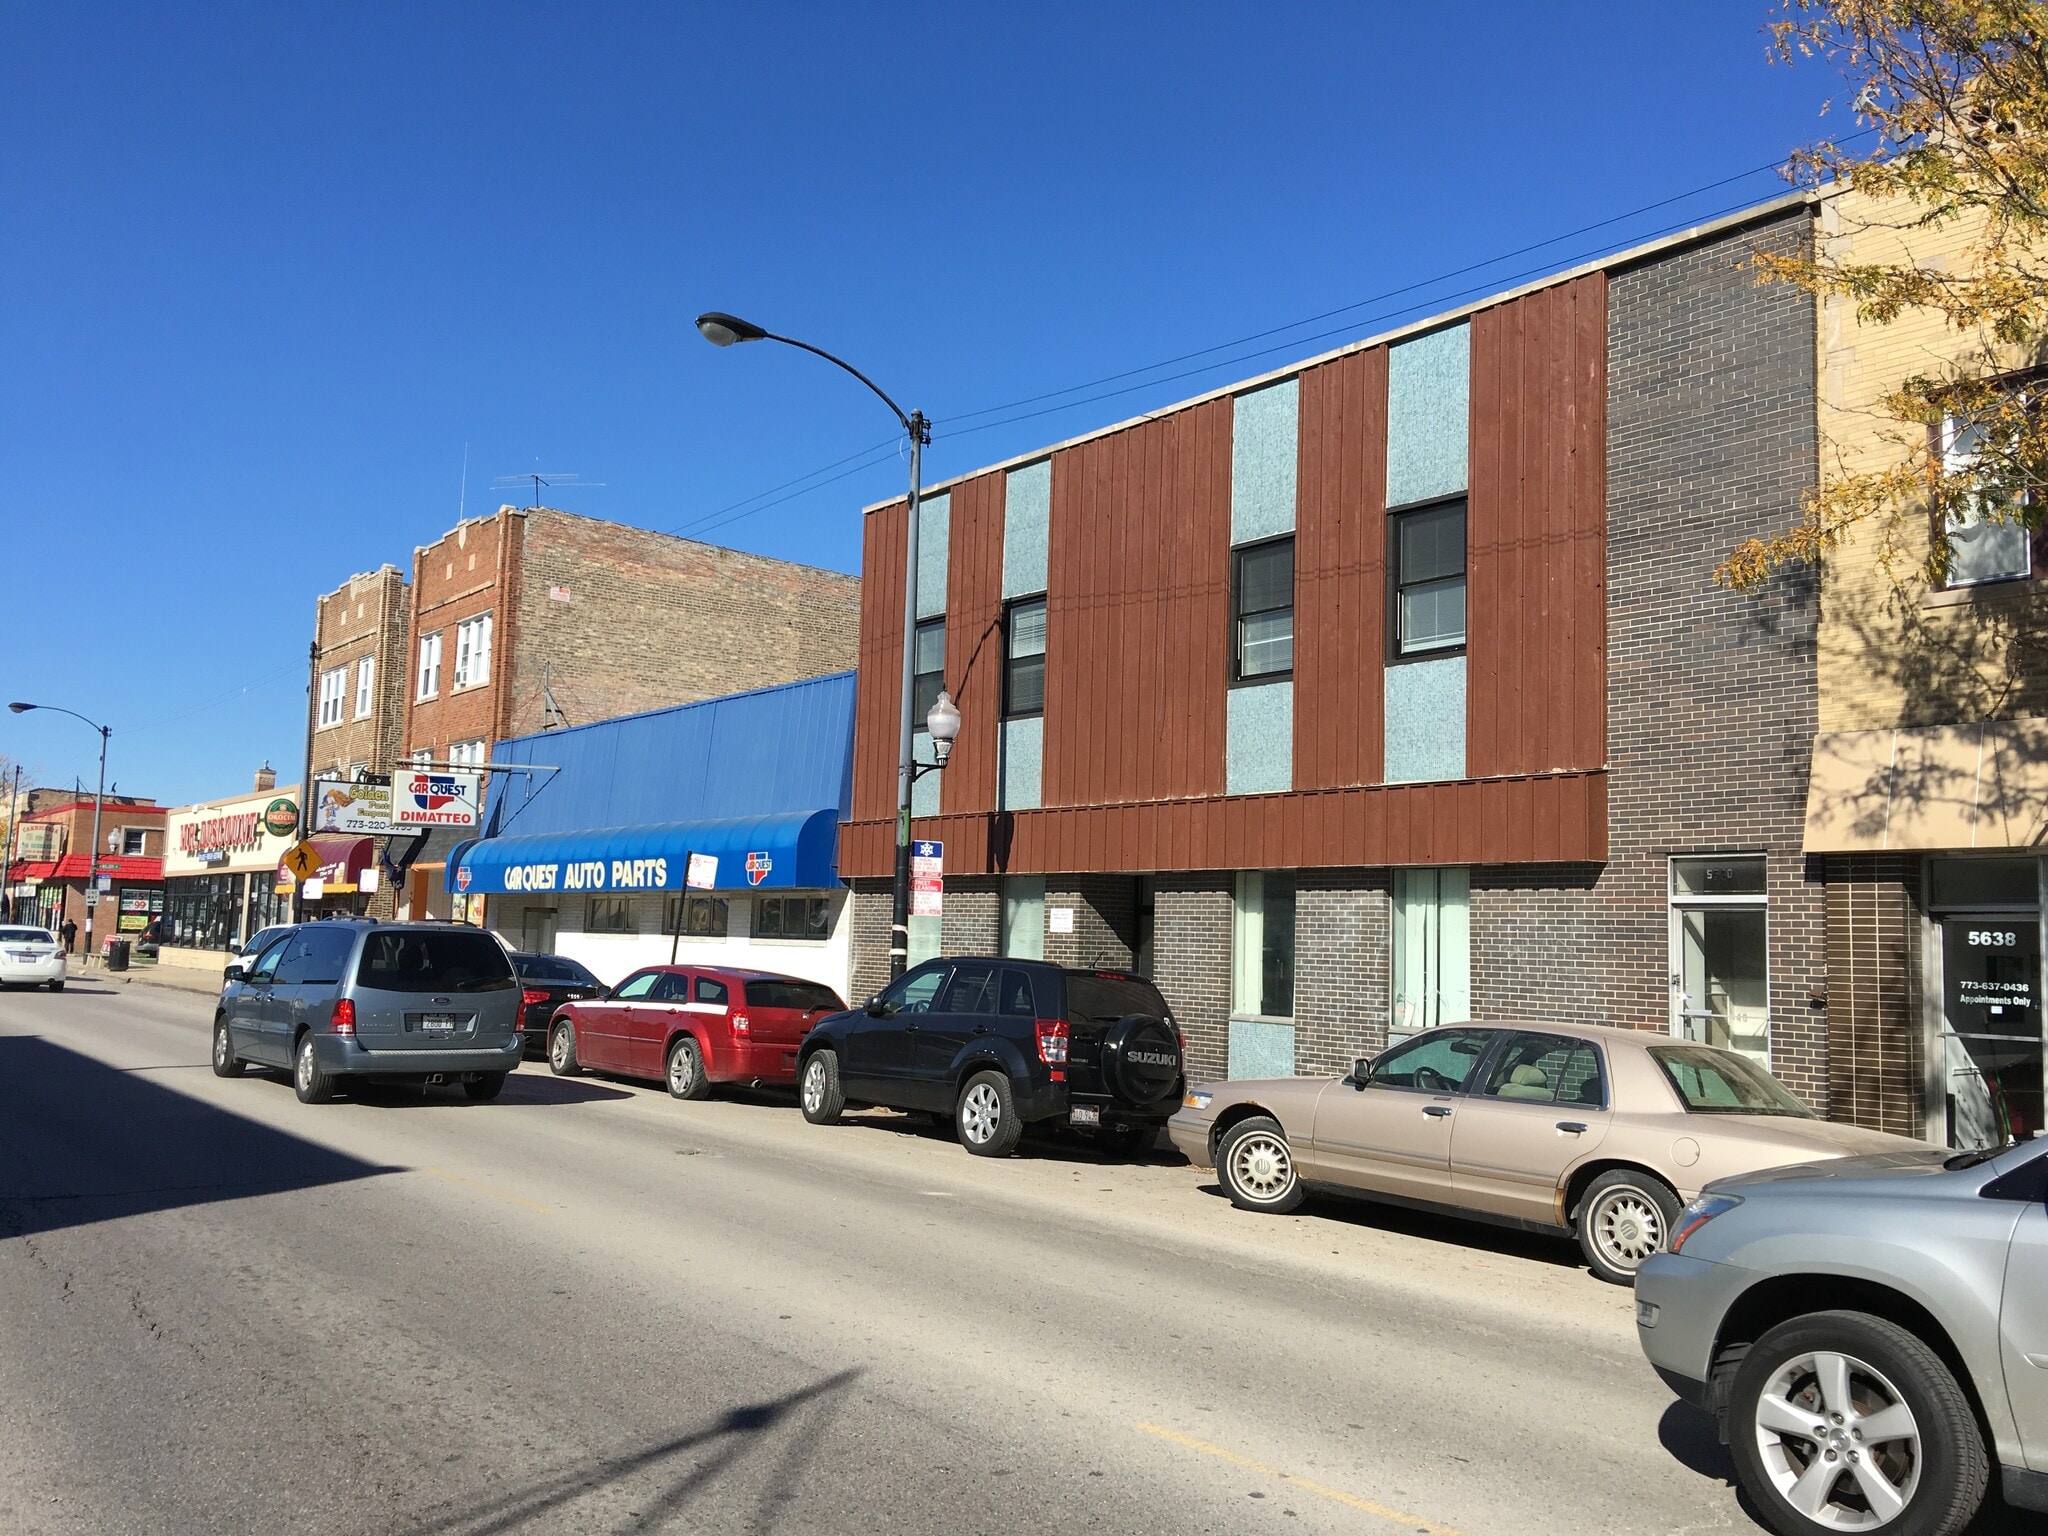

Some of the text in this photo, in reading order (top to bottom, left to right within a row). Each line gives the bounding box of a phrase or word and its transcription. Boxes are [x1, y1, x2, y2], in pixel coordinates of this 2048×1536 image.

[349, 785, 389, 801] Golden
[400, 811, 471, 824] DIMATTEO
[199, 812, 258, 849] DISCOUNT
[564, 861, 605, 889] AUTO
[611, 858, 667, 888] PARTS
[1968, 931, 2017, 947] 5638
[1960, 981, 2029, 992] 773-637-0436
[1960, 994, 2031, 1007] Appointments Only
[1127, 1051, 1177, 1066] SUZUKI
